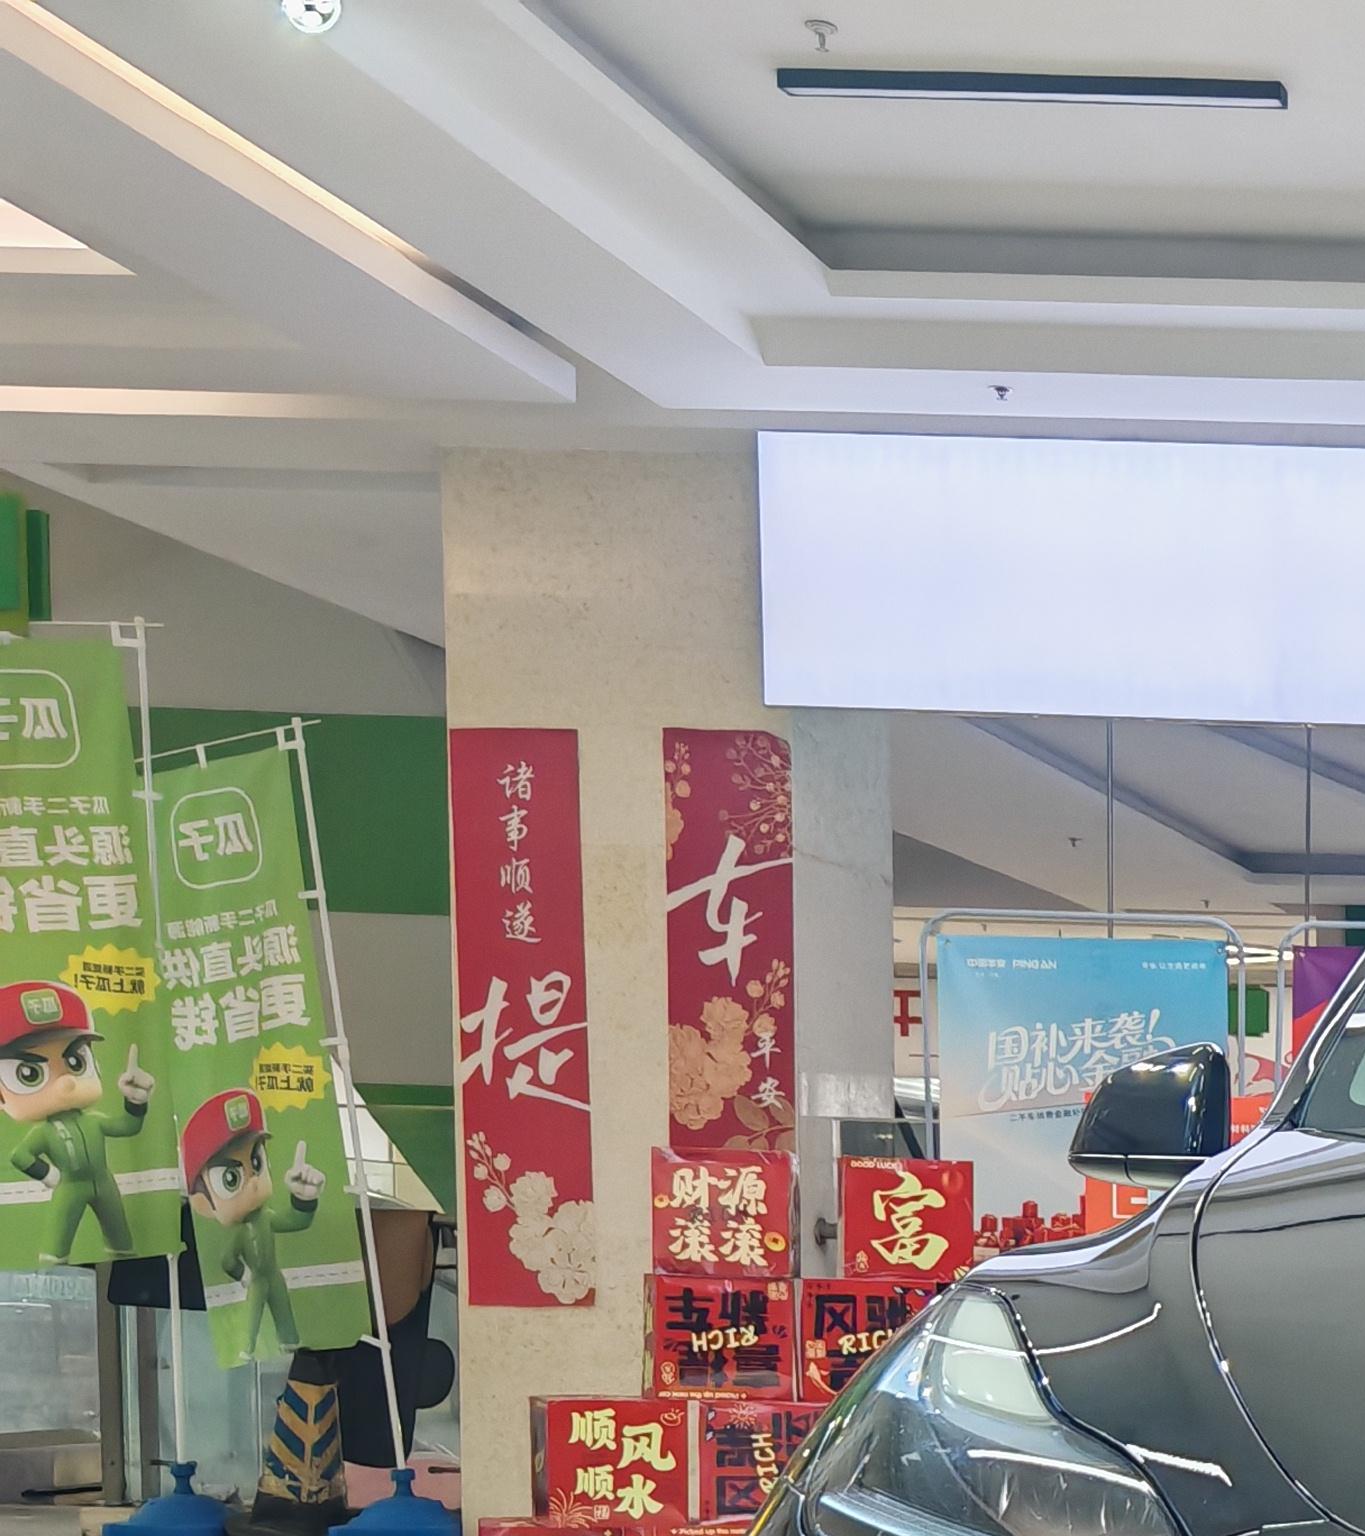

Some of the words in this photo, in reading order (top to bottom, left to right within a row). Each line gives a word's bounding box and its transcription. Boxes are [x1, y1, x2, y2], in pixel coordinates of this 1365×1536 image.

[497, 762, 542, 944] 诸事顺遂
[667, 836, 793, 986] 车
[750, 1032, 785, 1110] 平安
[669, 1166, 767, 1215] 财源
[871, 1170, 949, 1271] 富
[668, 1218, 766, 1266] 滚滚
[692, 1325, 759, 1352] RICH
[568, 1407, 677, 1471] 顺风
[574, 1464, 664, 1519] 顺水
